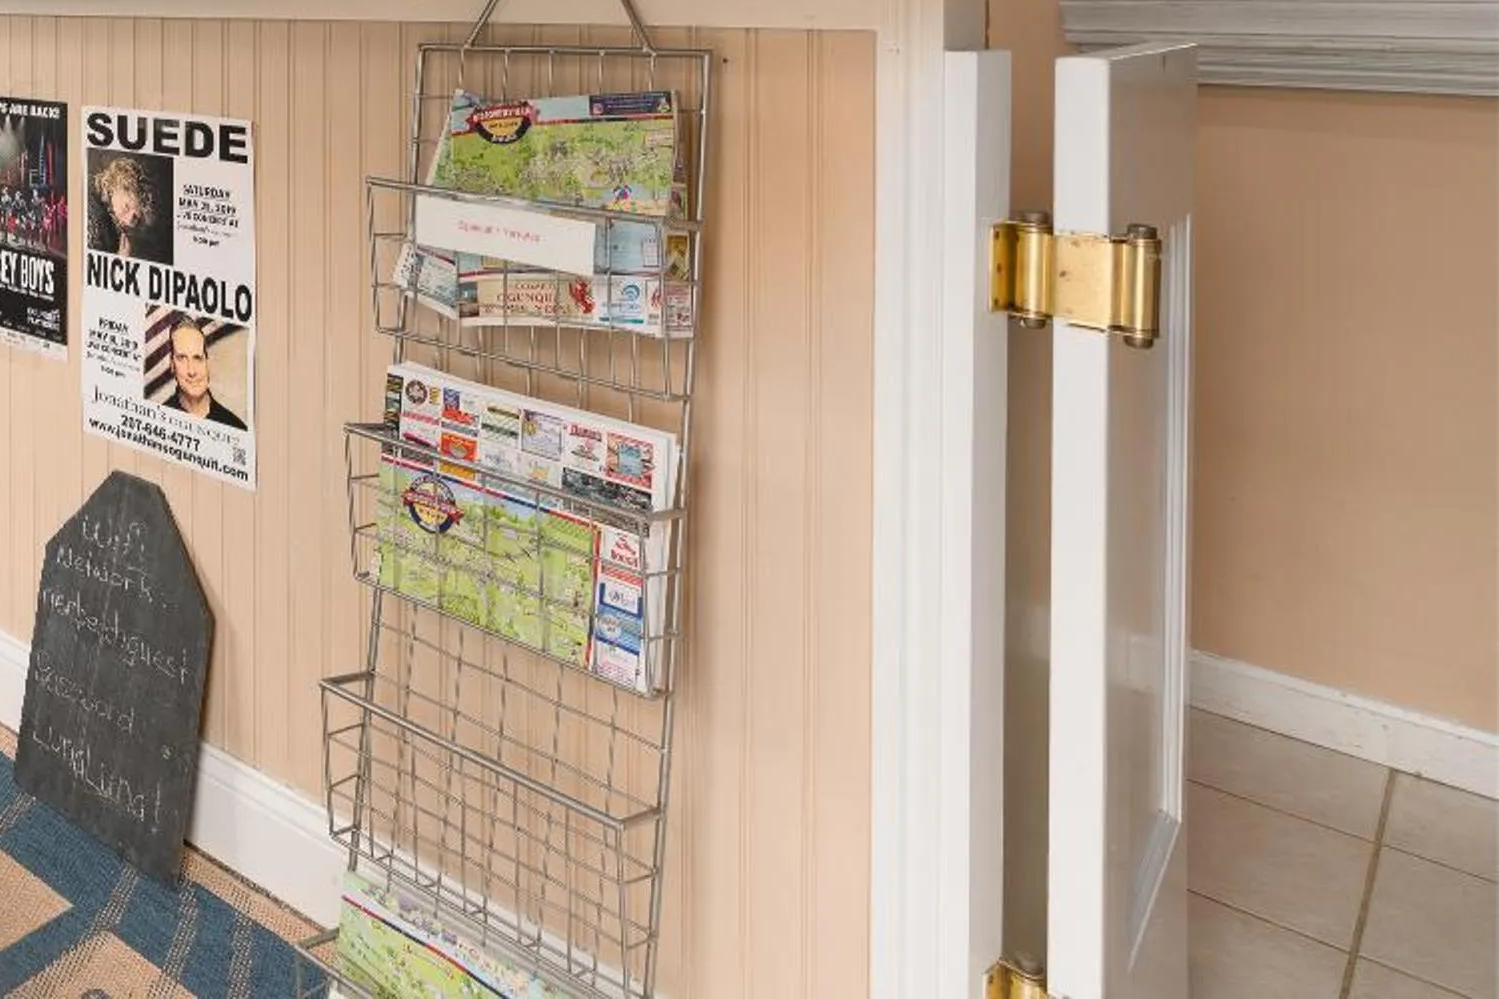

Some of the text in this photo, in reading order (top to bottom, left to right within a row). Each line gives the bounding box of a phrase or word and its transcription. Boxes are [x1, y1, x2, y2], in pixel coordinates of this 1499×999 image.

[9, 102, 29, 116] ARE
[86, 112, 249, 165] SUEDE
[20, 254, 55, 294] BOYS
[87, 252, 141, 297] NICK
[149, 264, 252, 323] DIPAOLO
